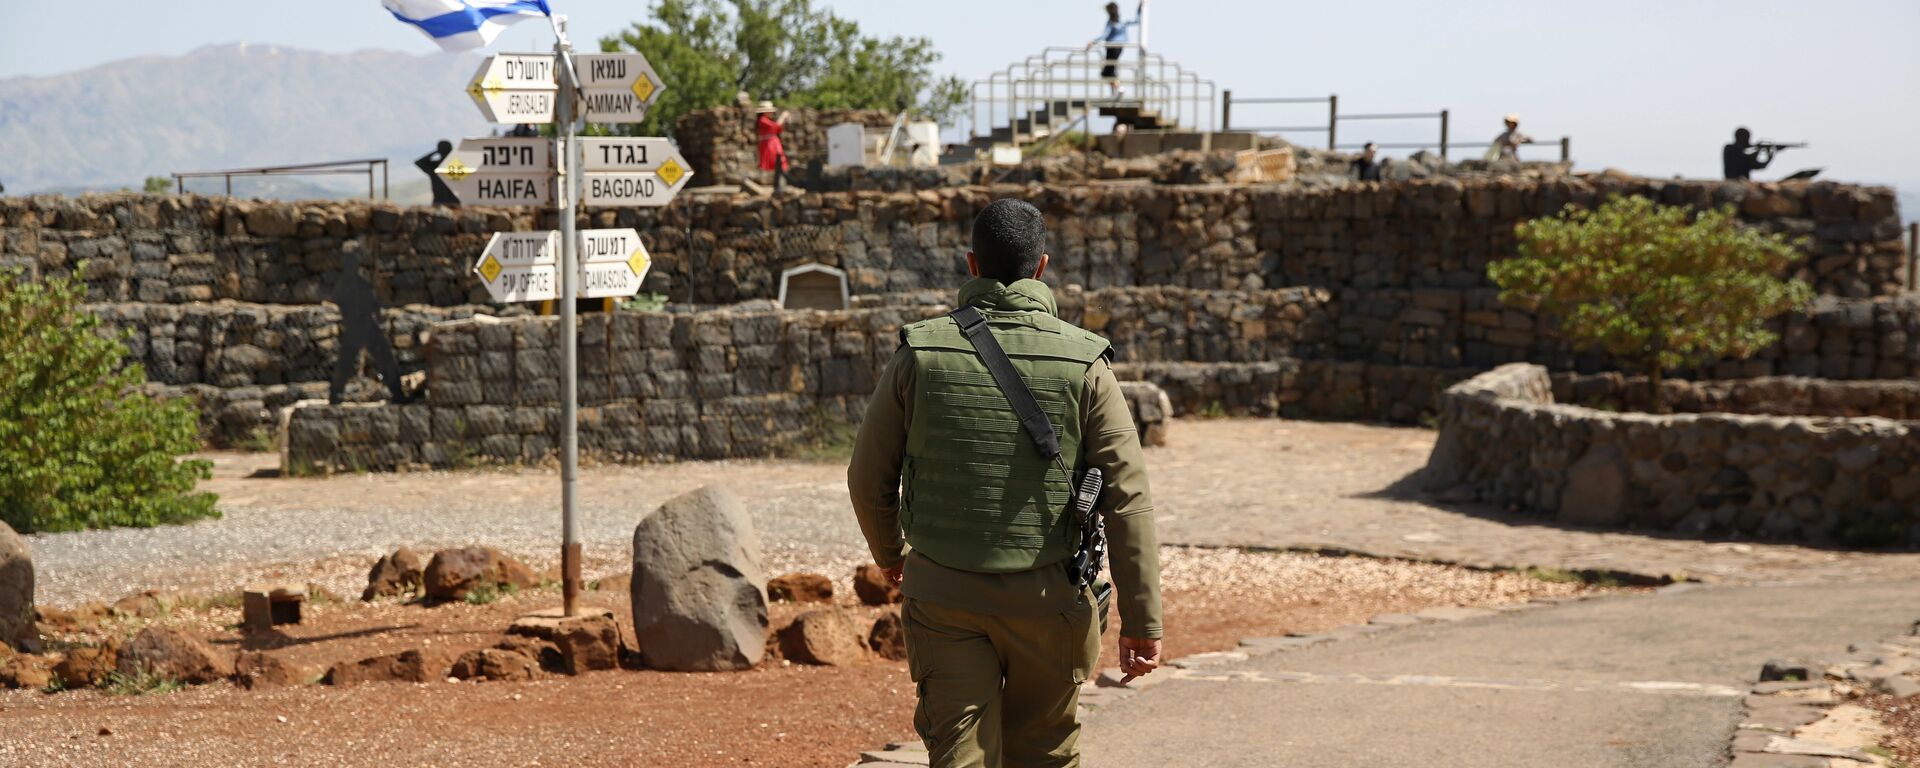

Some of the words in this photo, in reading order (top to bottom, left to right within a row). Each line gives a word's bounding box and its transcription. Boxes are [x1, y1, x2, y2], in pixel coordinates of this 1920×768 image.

[506, 57, 549, 80] ירושלים
[591, 59, 626, 82] עמאן
[507, 95, 549, 114] JERUSALEM
[586, 94, 632, 113] AMMAN
[483, 146, 533, 165] חיפה
[599, 145, 648, 164] בגדד
[478, 179, 537, 199] HAIFA
[592, 179, 655, 198] BAGDAD
[587, 236, 627, 259] דמשק
[520, 272, 548, 293] OFFICE
[585, 269, 628, 290] DAMASCUS
